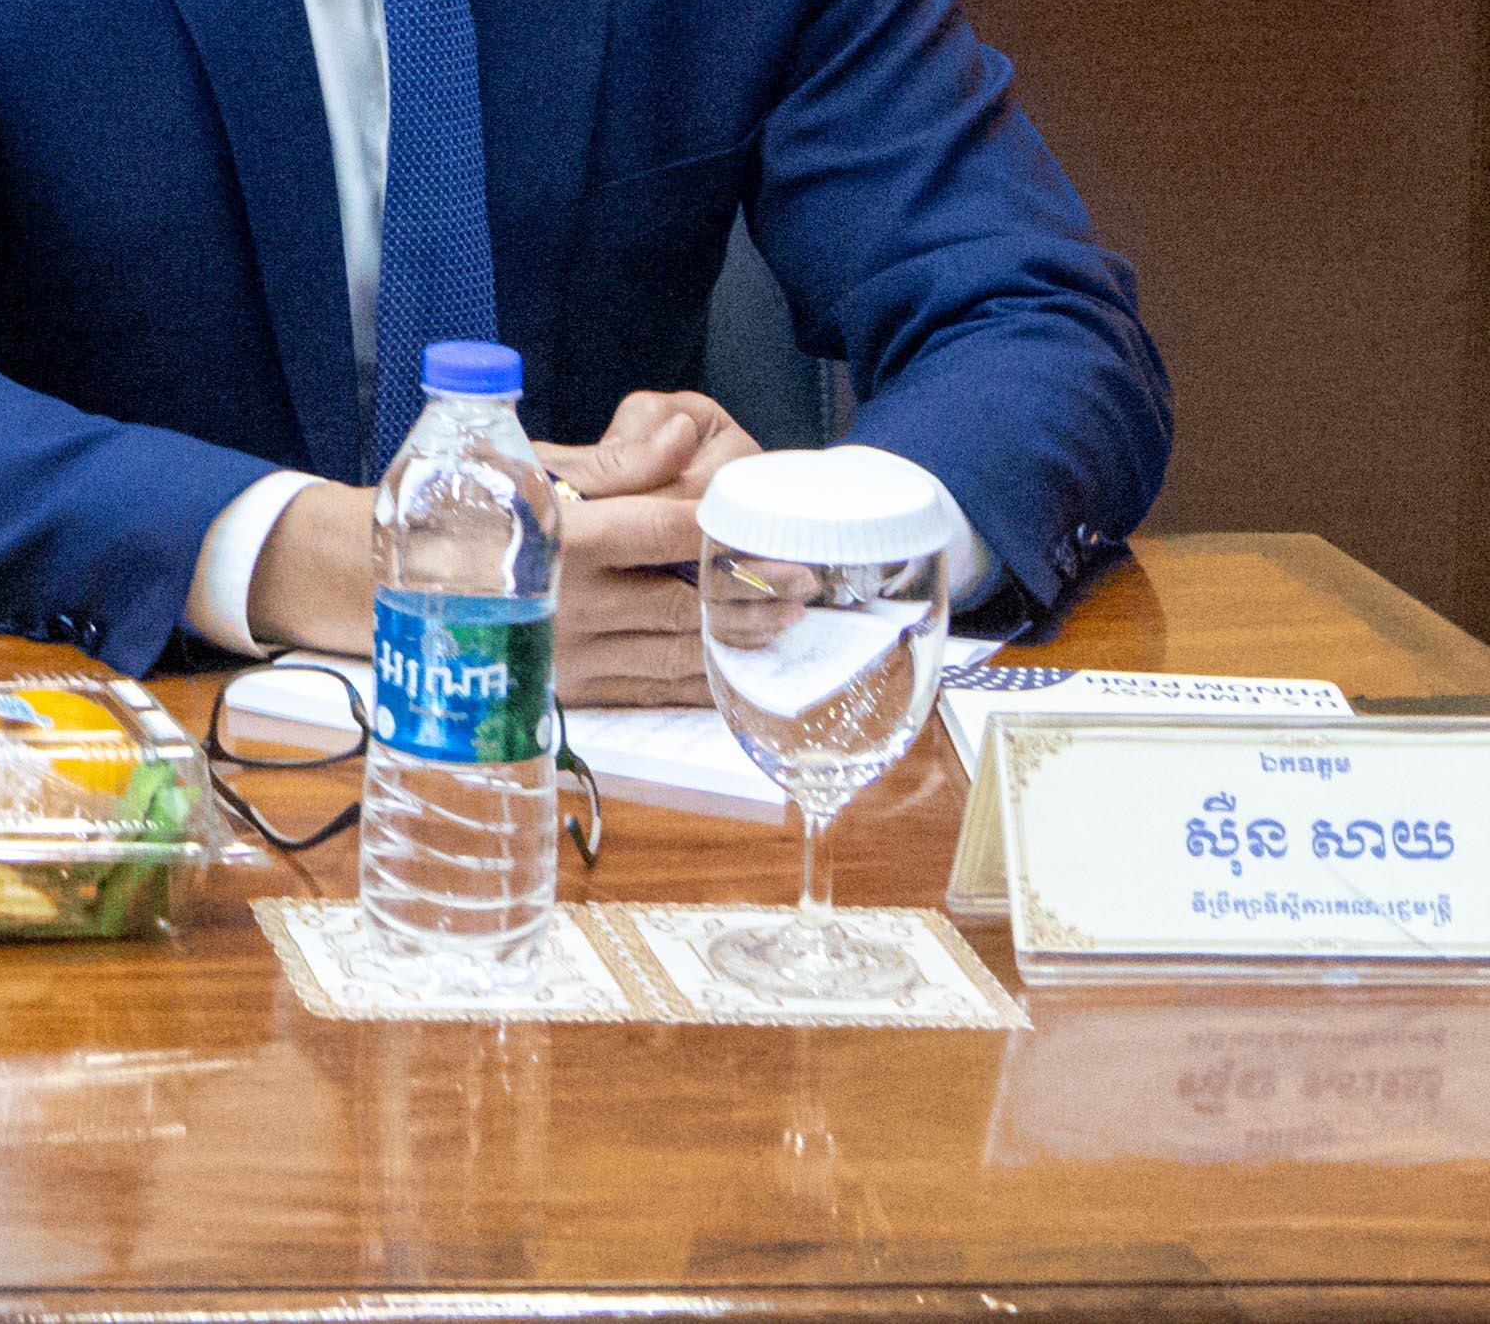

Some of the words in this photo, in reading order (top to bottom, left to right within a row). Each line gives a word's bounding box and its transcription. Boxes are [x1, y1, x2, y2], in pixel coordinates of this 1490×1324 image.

[1085, 676, 1181, 690] PENH
[1193, 682, 1332, 698] PHNOM
[1101, 687, 1261, 704] EMBASSY
[1259, 752, 1351, 781] ឯកឧត្តម
[1312, 818, 1456, 860] សាយ
